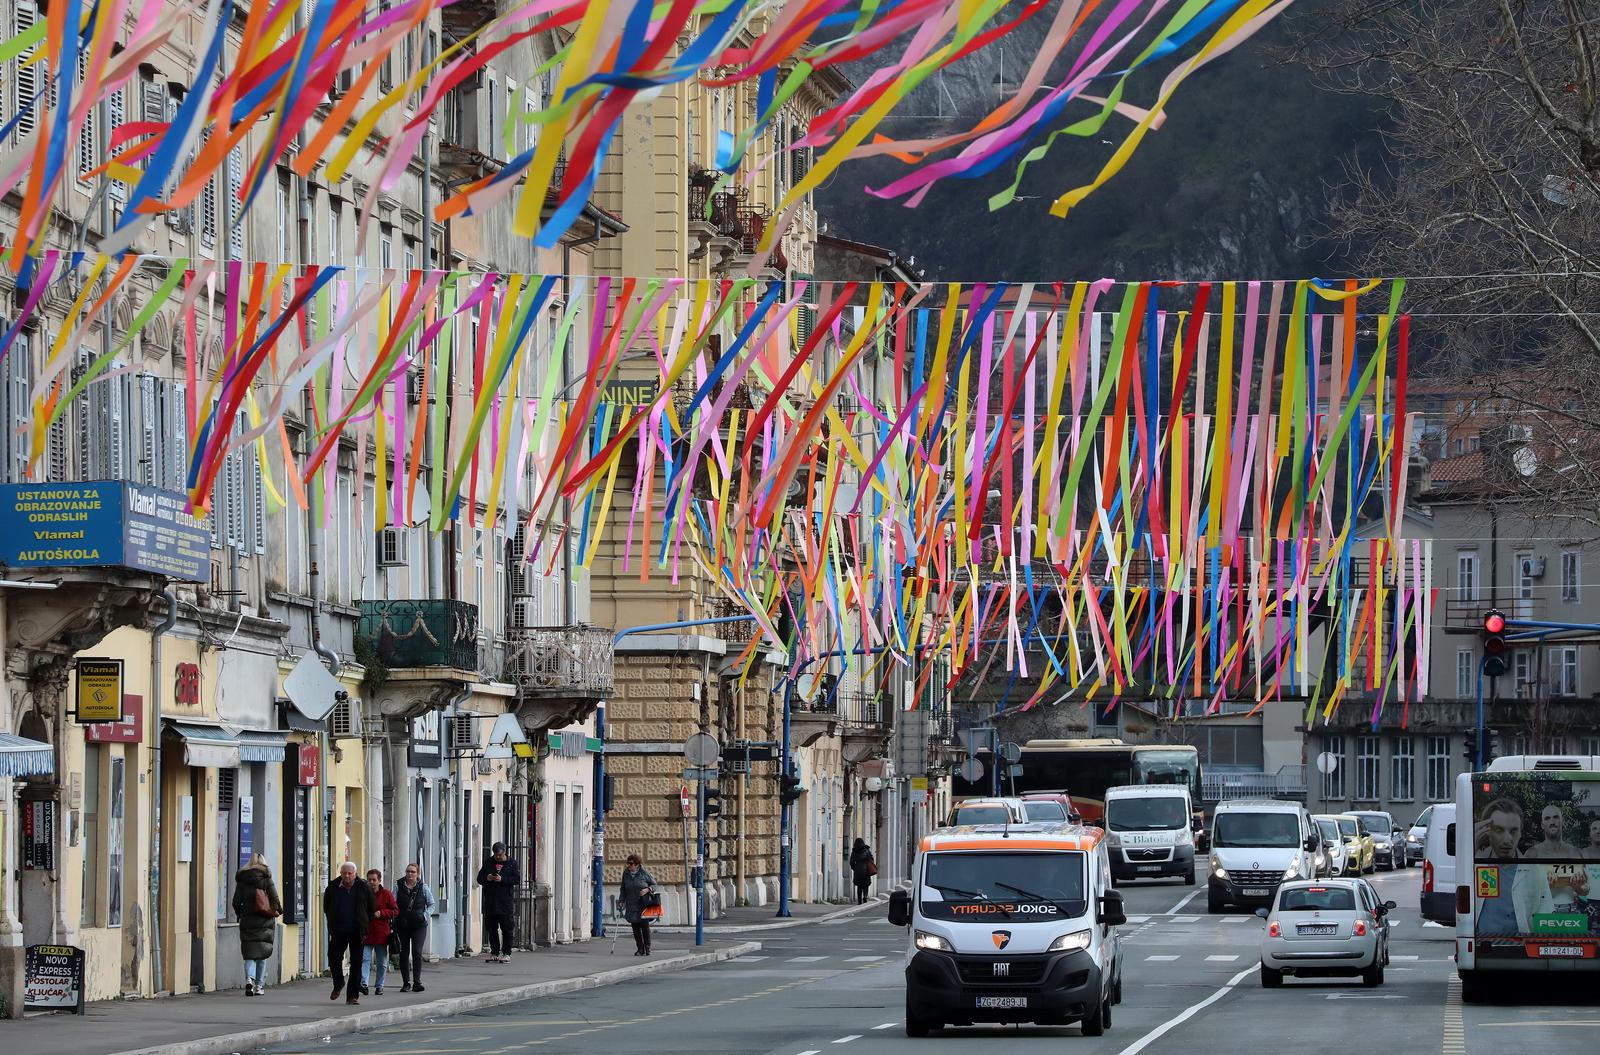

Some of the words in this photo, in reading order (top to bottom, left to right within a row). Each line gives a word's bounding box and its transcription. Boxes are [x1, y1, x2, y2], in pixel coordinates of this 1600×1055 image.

[602, 386, 651, 406] NINE
[17, 490, 80, 500] USTANOVA
[83, 490, 99, 498] ZA
[15, 501, 101, 511] OBRAZOVANJE
[29, 512, 88, 522] ODRASLIH
[18, 547, 99, 561] AUTOŠKOLA
[1552, 865, 1574, 873] 711
[46, 956, 68, 964] NOVO
[39, 966, 72, 976] EXPRESS
[993, 963, 1010, 976] FIAT
[981, 997, 992, 1007] ZG
